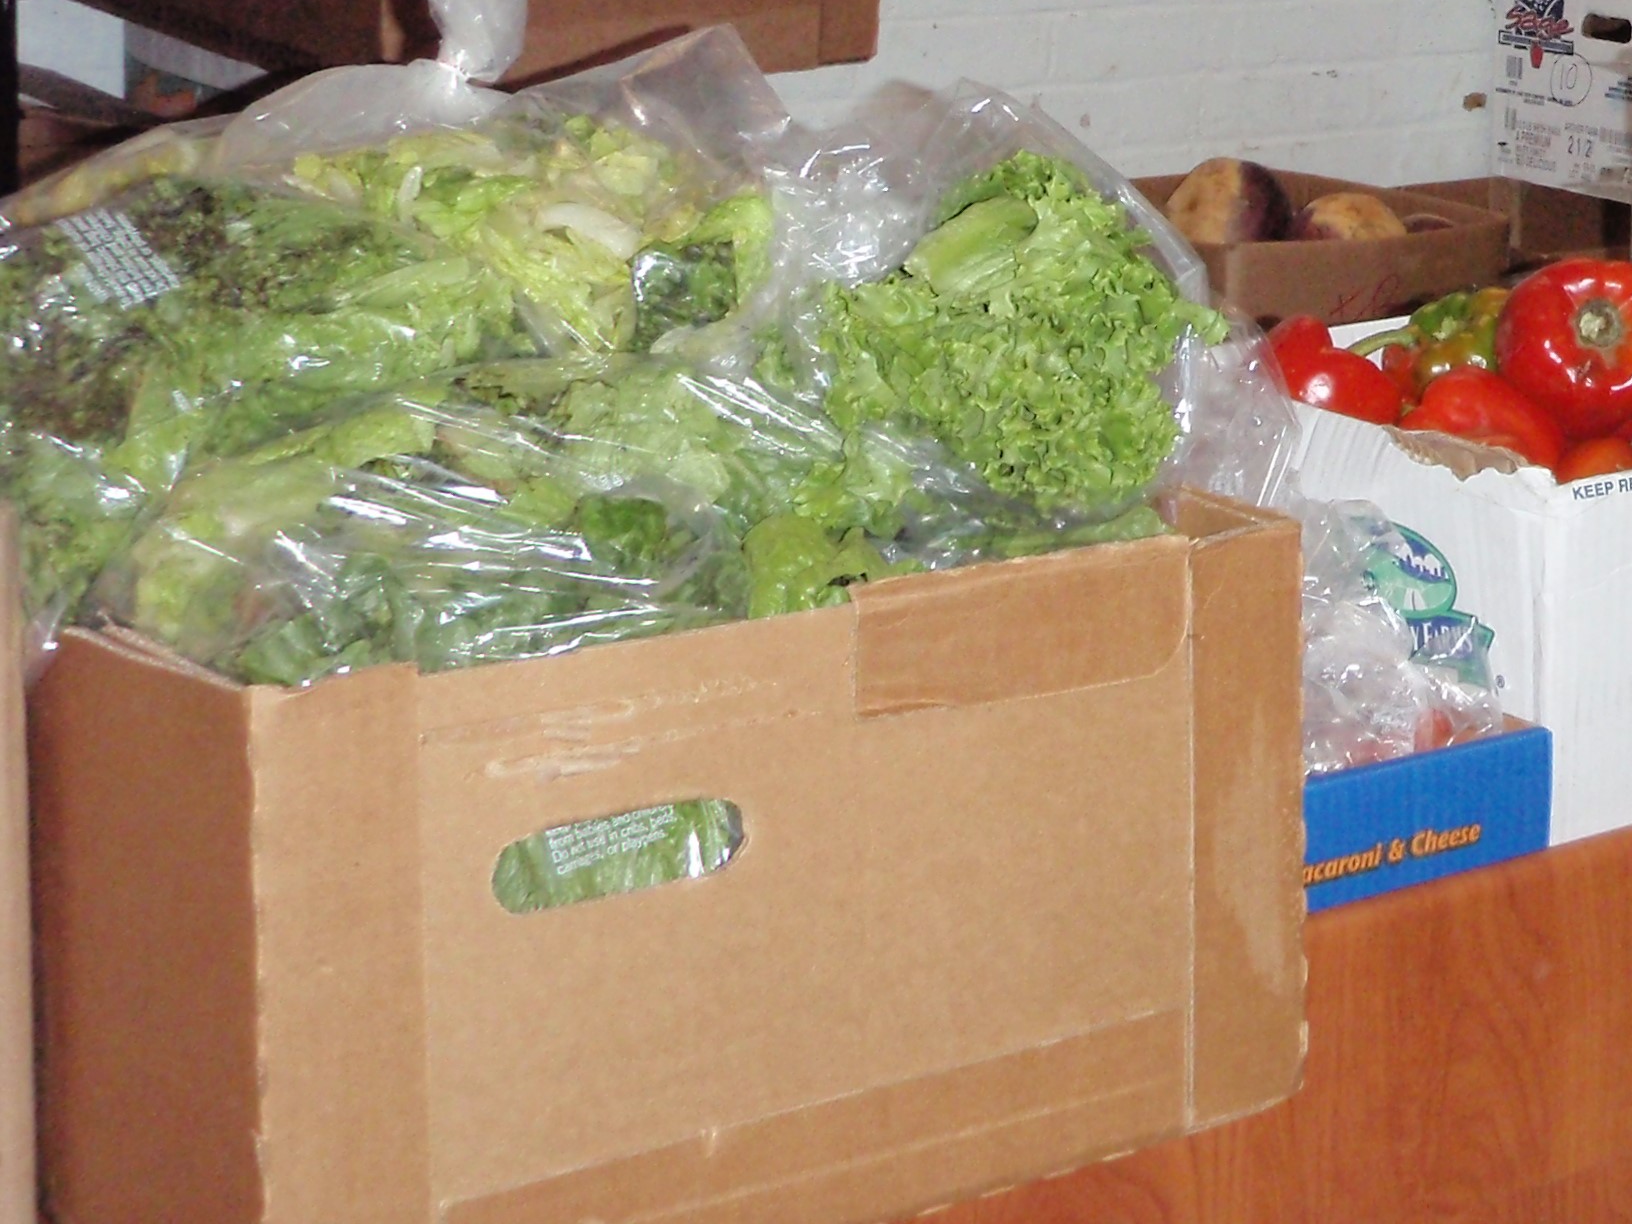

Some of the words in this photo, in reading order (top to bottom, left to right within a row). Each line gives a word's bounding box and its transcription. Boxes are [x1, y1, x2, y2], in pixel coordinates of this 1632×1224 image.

[1572, 481, 1614, 501] KEEP
[552, 850, 569, 863] Do
[1302, 842, 1384, 886] acaroni
[1387, 838, 1406, 863] &
[1410, 824, 1482, 857] Cheese
